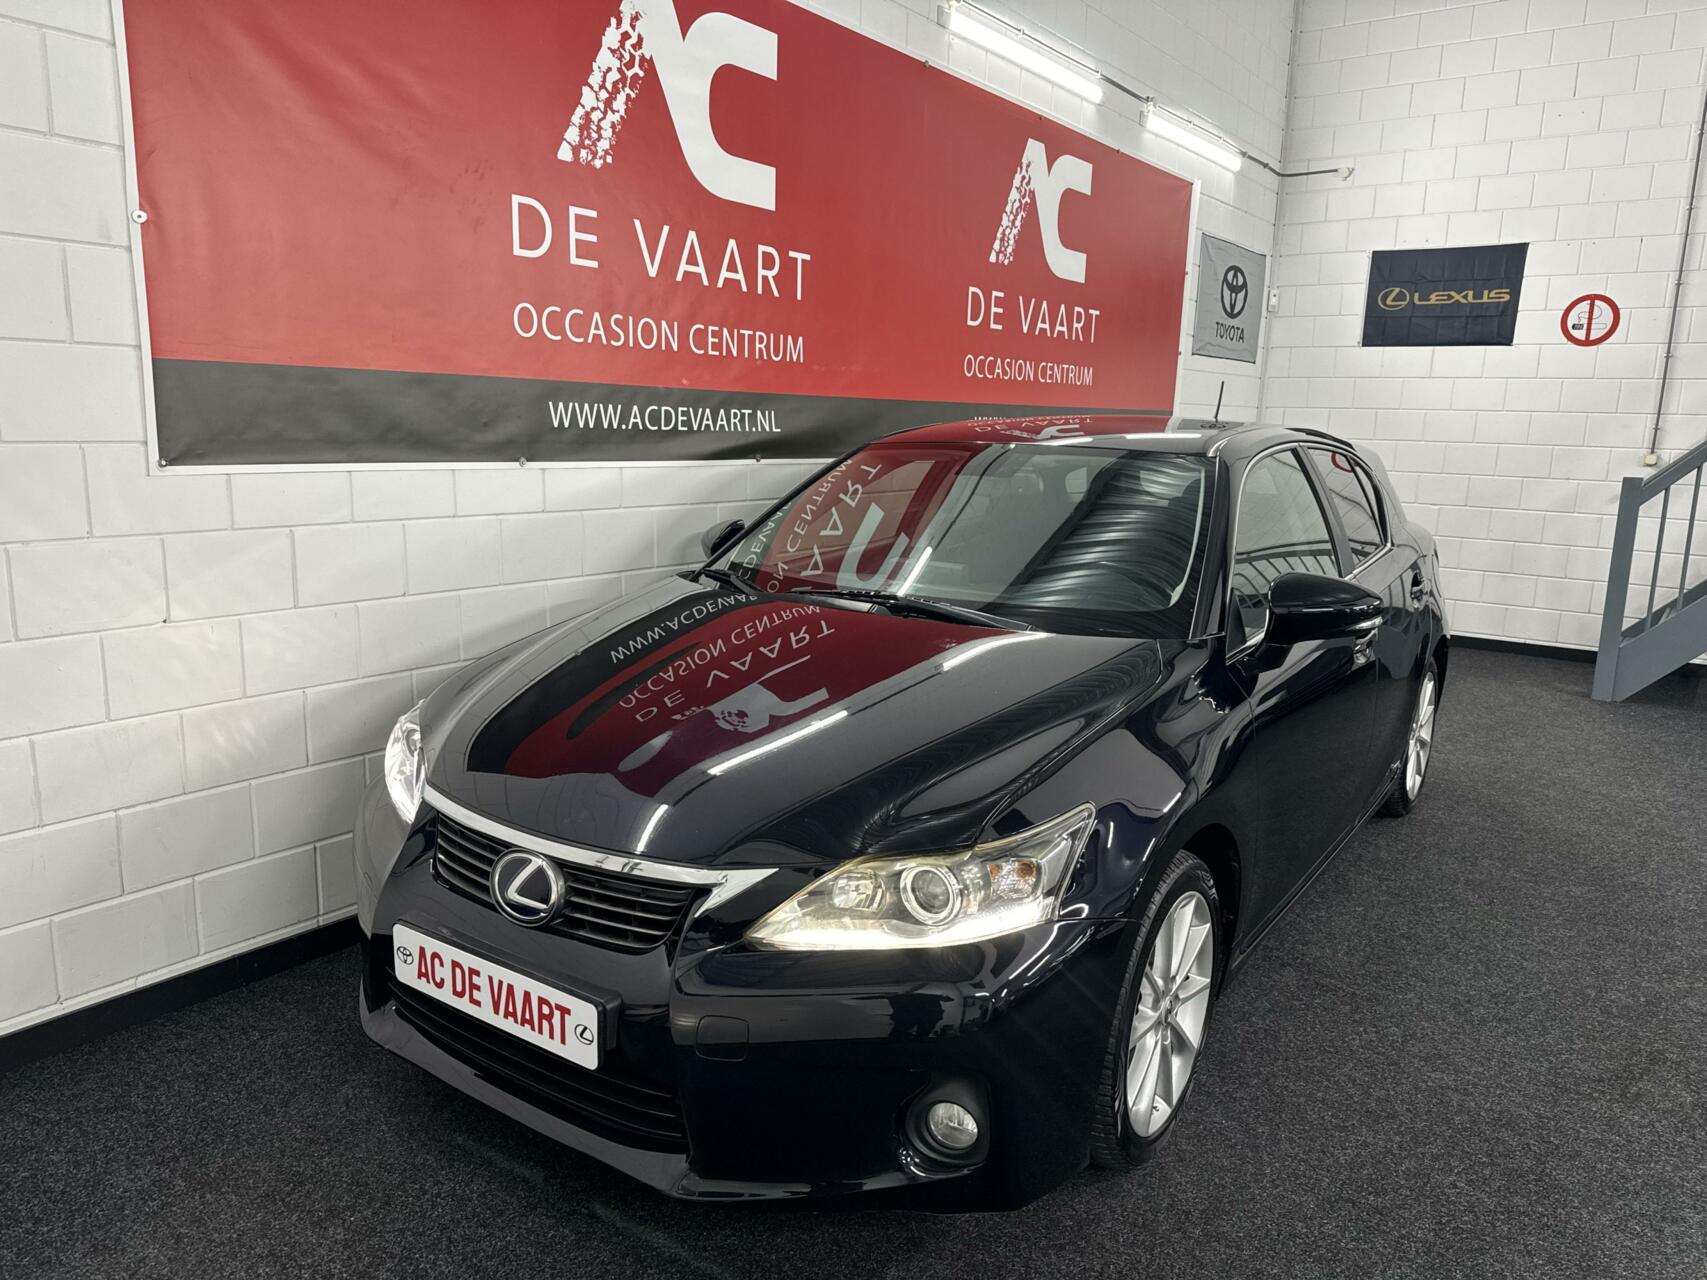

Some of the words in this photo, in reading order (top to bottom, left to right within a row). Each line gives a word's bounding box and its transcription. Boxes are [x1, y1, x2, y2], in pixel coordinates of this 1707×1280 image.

[511, 193, 599, 269] DE
[633, 218, 811, 301] VAART
[966, 285, 1005, 331] DE
[1018, 295, 1101, 344] VAART
[1413, 288, 1511, 305] LEXUS
[512, 302, 679, 352] OCCASION
[688, 323, 804, 364] CENTRUM
[1215, 321, 1245, 344] TOYOTA
[963, 353, 1035, 382] OCCASION
[1038, 361, 1093, 386] CENTRUM
[548, 400, 782, 433] WWW.ACDEVAART.NL
[417, 945, 445, 990] AC
[451, 959, 482, 1008] DE
[487, 974, 572, 1046] VAART
